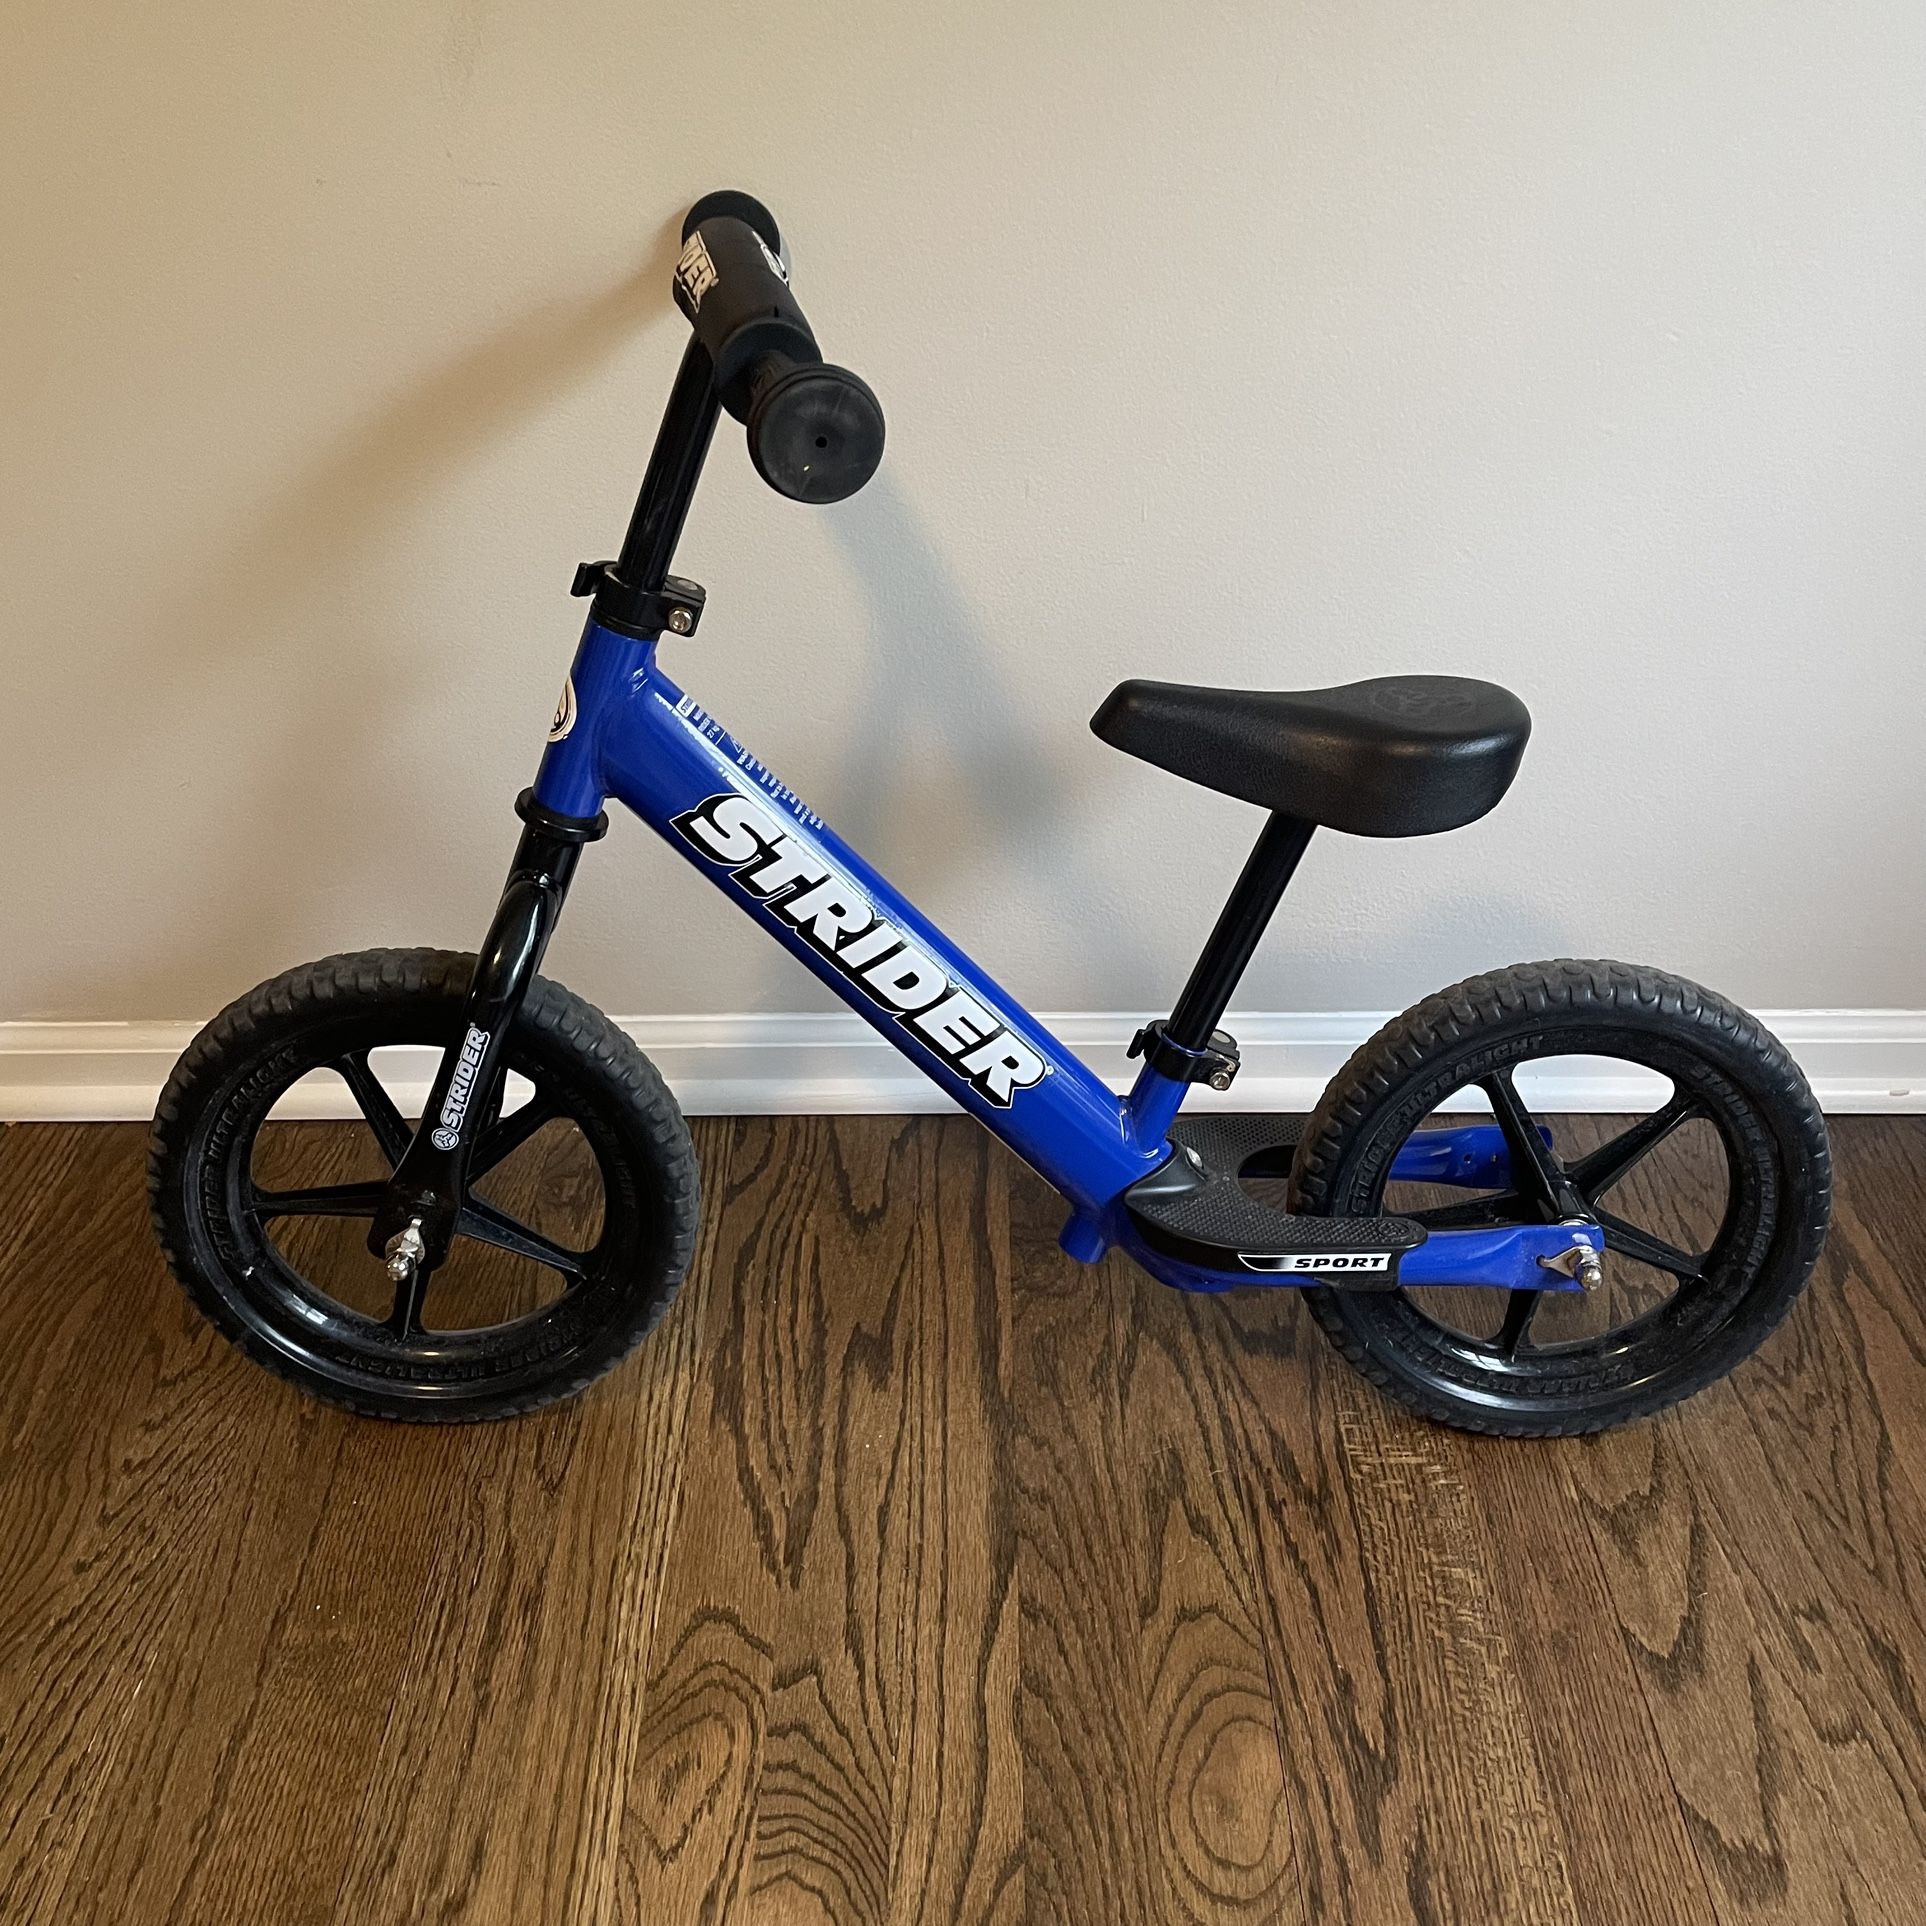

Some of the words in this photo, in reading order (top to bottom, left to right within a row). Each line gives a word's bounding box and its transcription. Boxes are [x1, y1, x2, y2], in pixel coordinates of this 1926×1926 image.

[673, 793, 1046, 1107] STRIDER
[441, 1027, 490, 1132] STRIDER
[1294, 1257, 1384, 1269] SPORT
